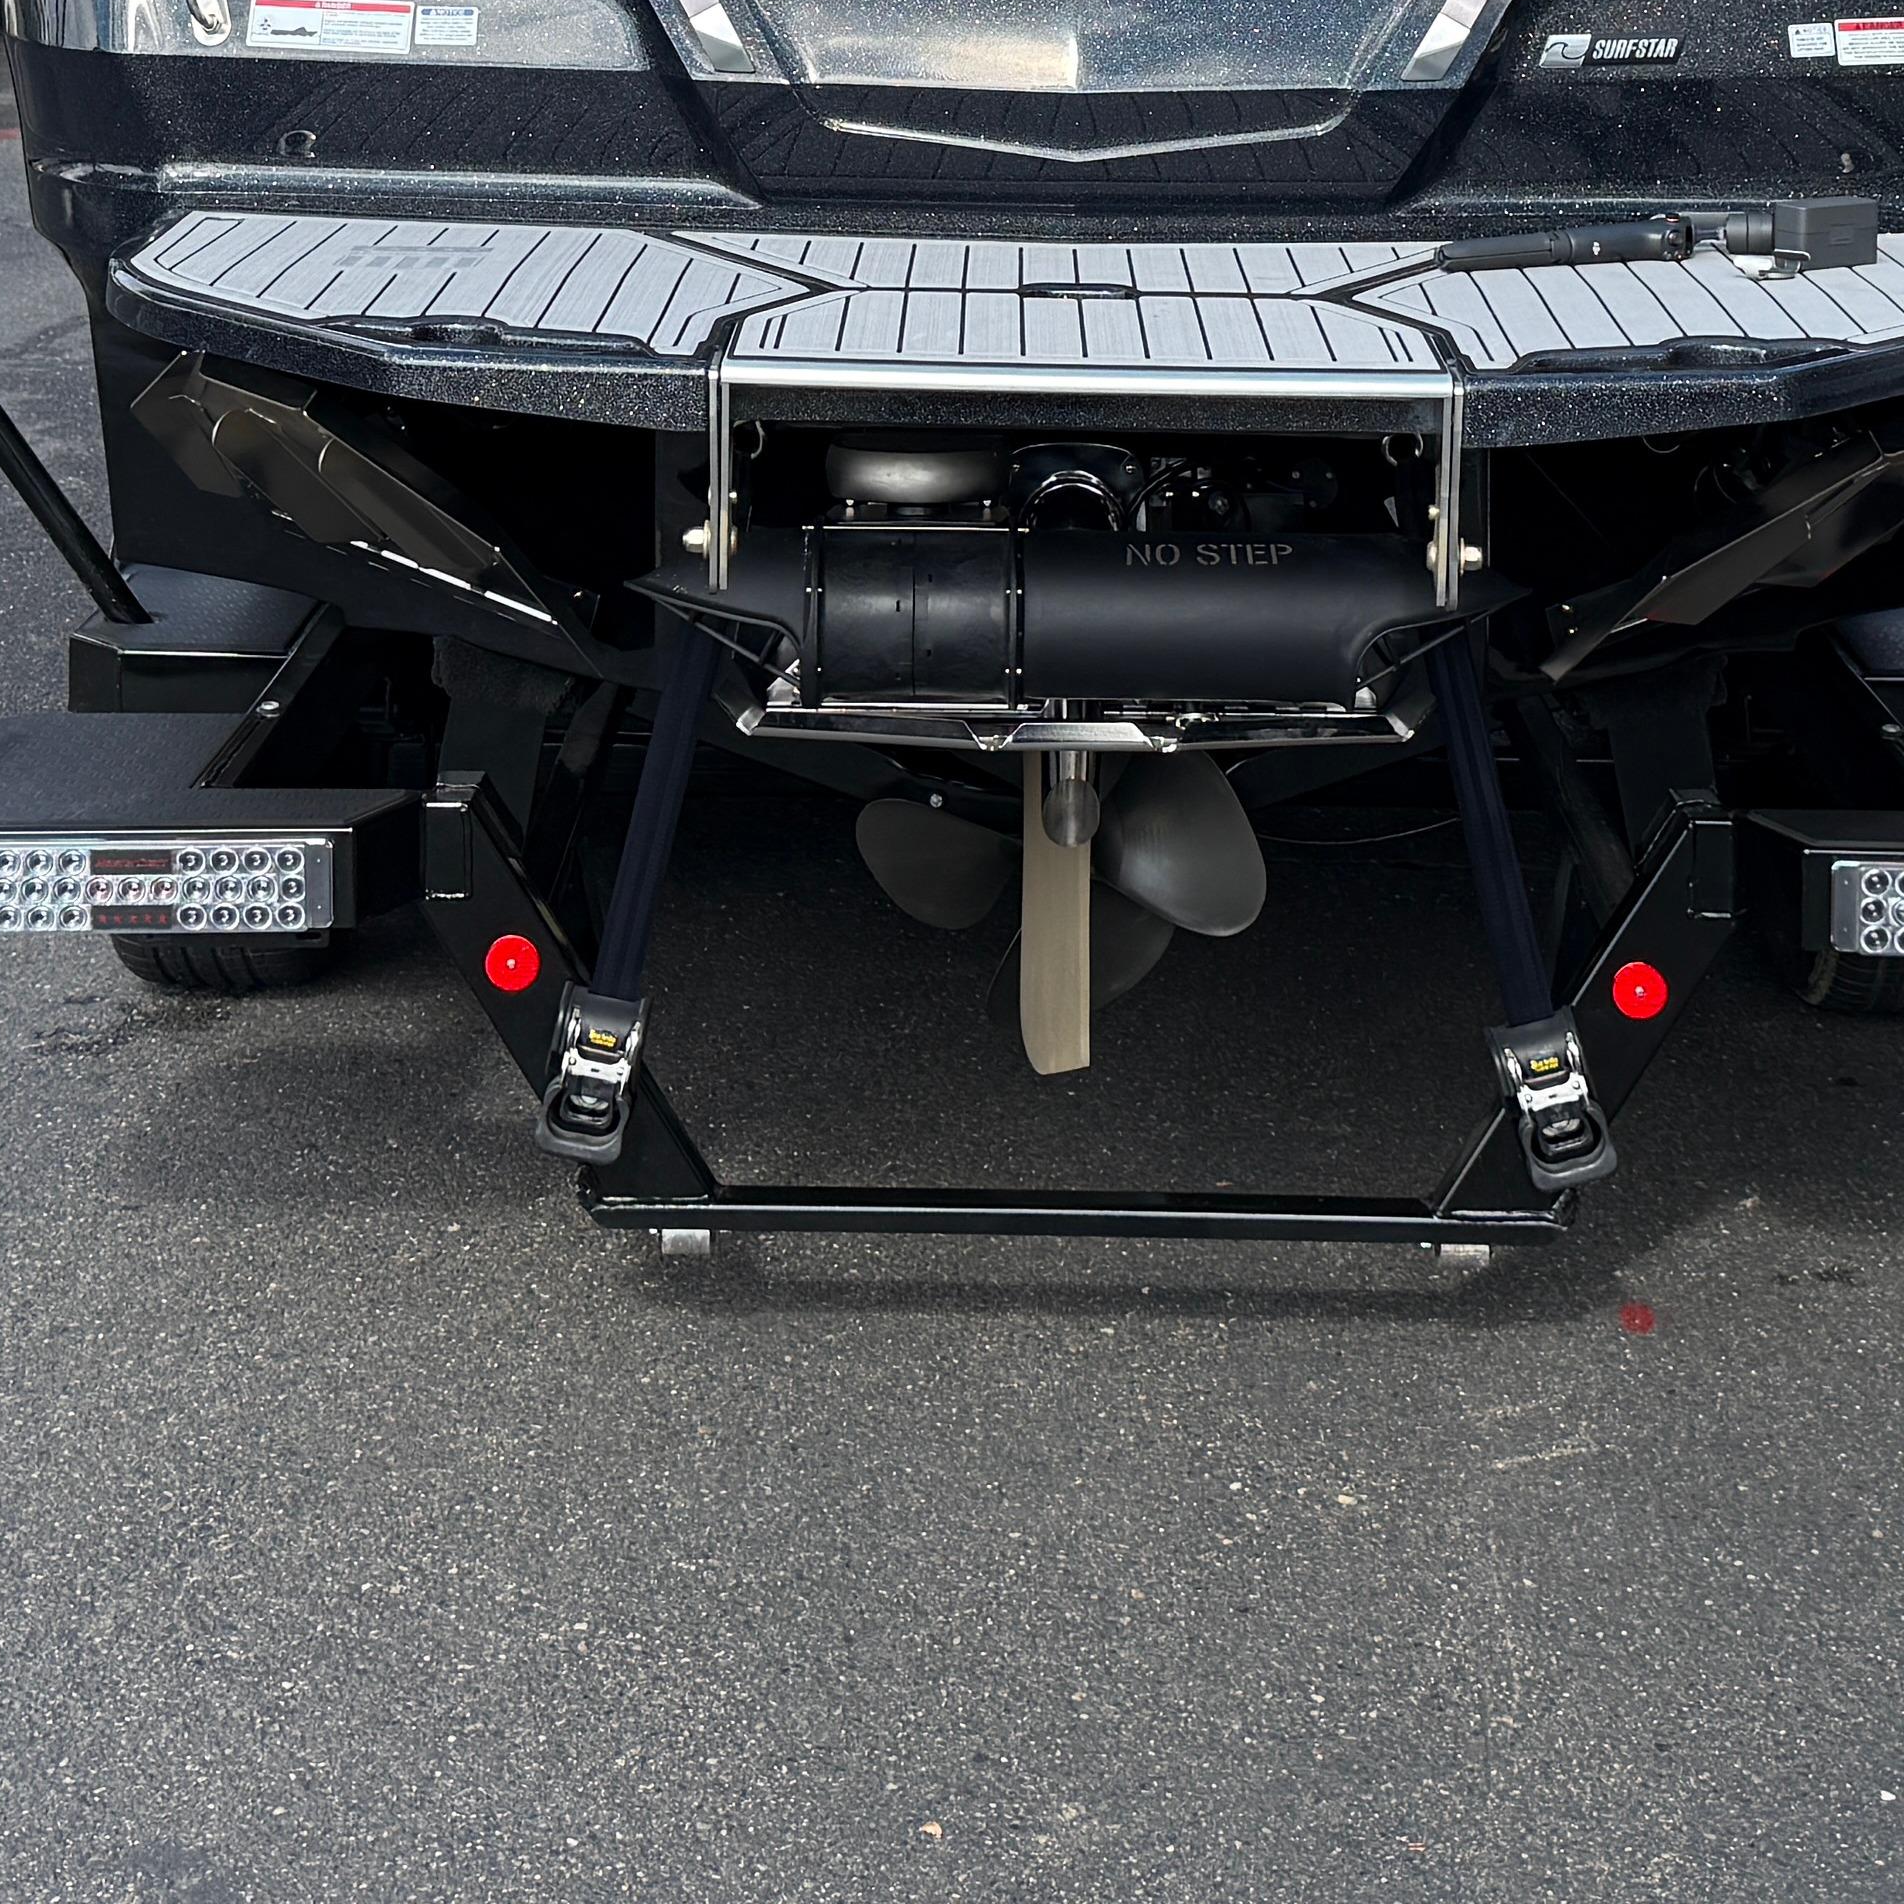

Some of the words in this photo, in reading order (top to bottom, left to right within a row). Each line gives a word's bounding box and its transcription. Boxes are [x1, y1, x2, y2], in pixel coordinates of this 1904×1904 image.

[1592, 38, 1679, 60] SURFSTAR
[1125, 543, 1180, 566] NO
[1196, 543, 1293, 566] STEP
